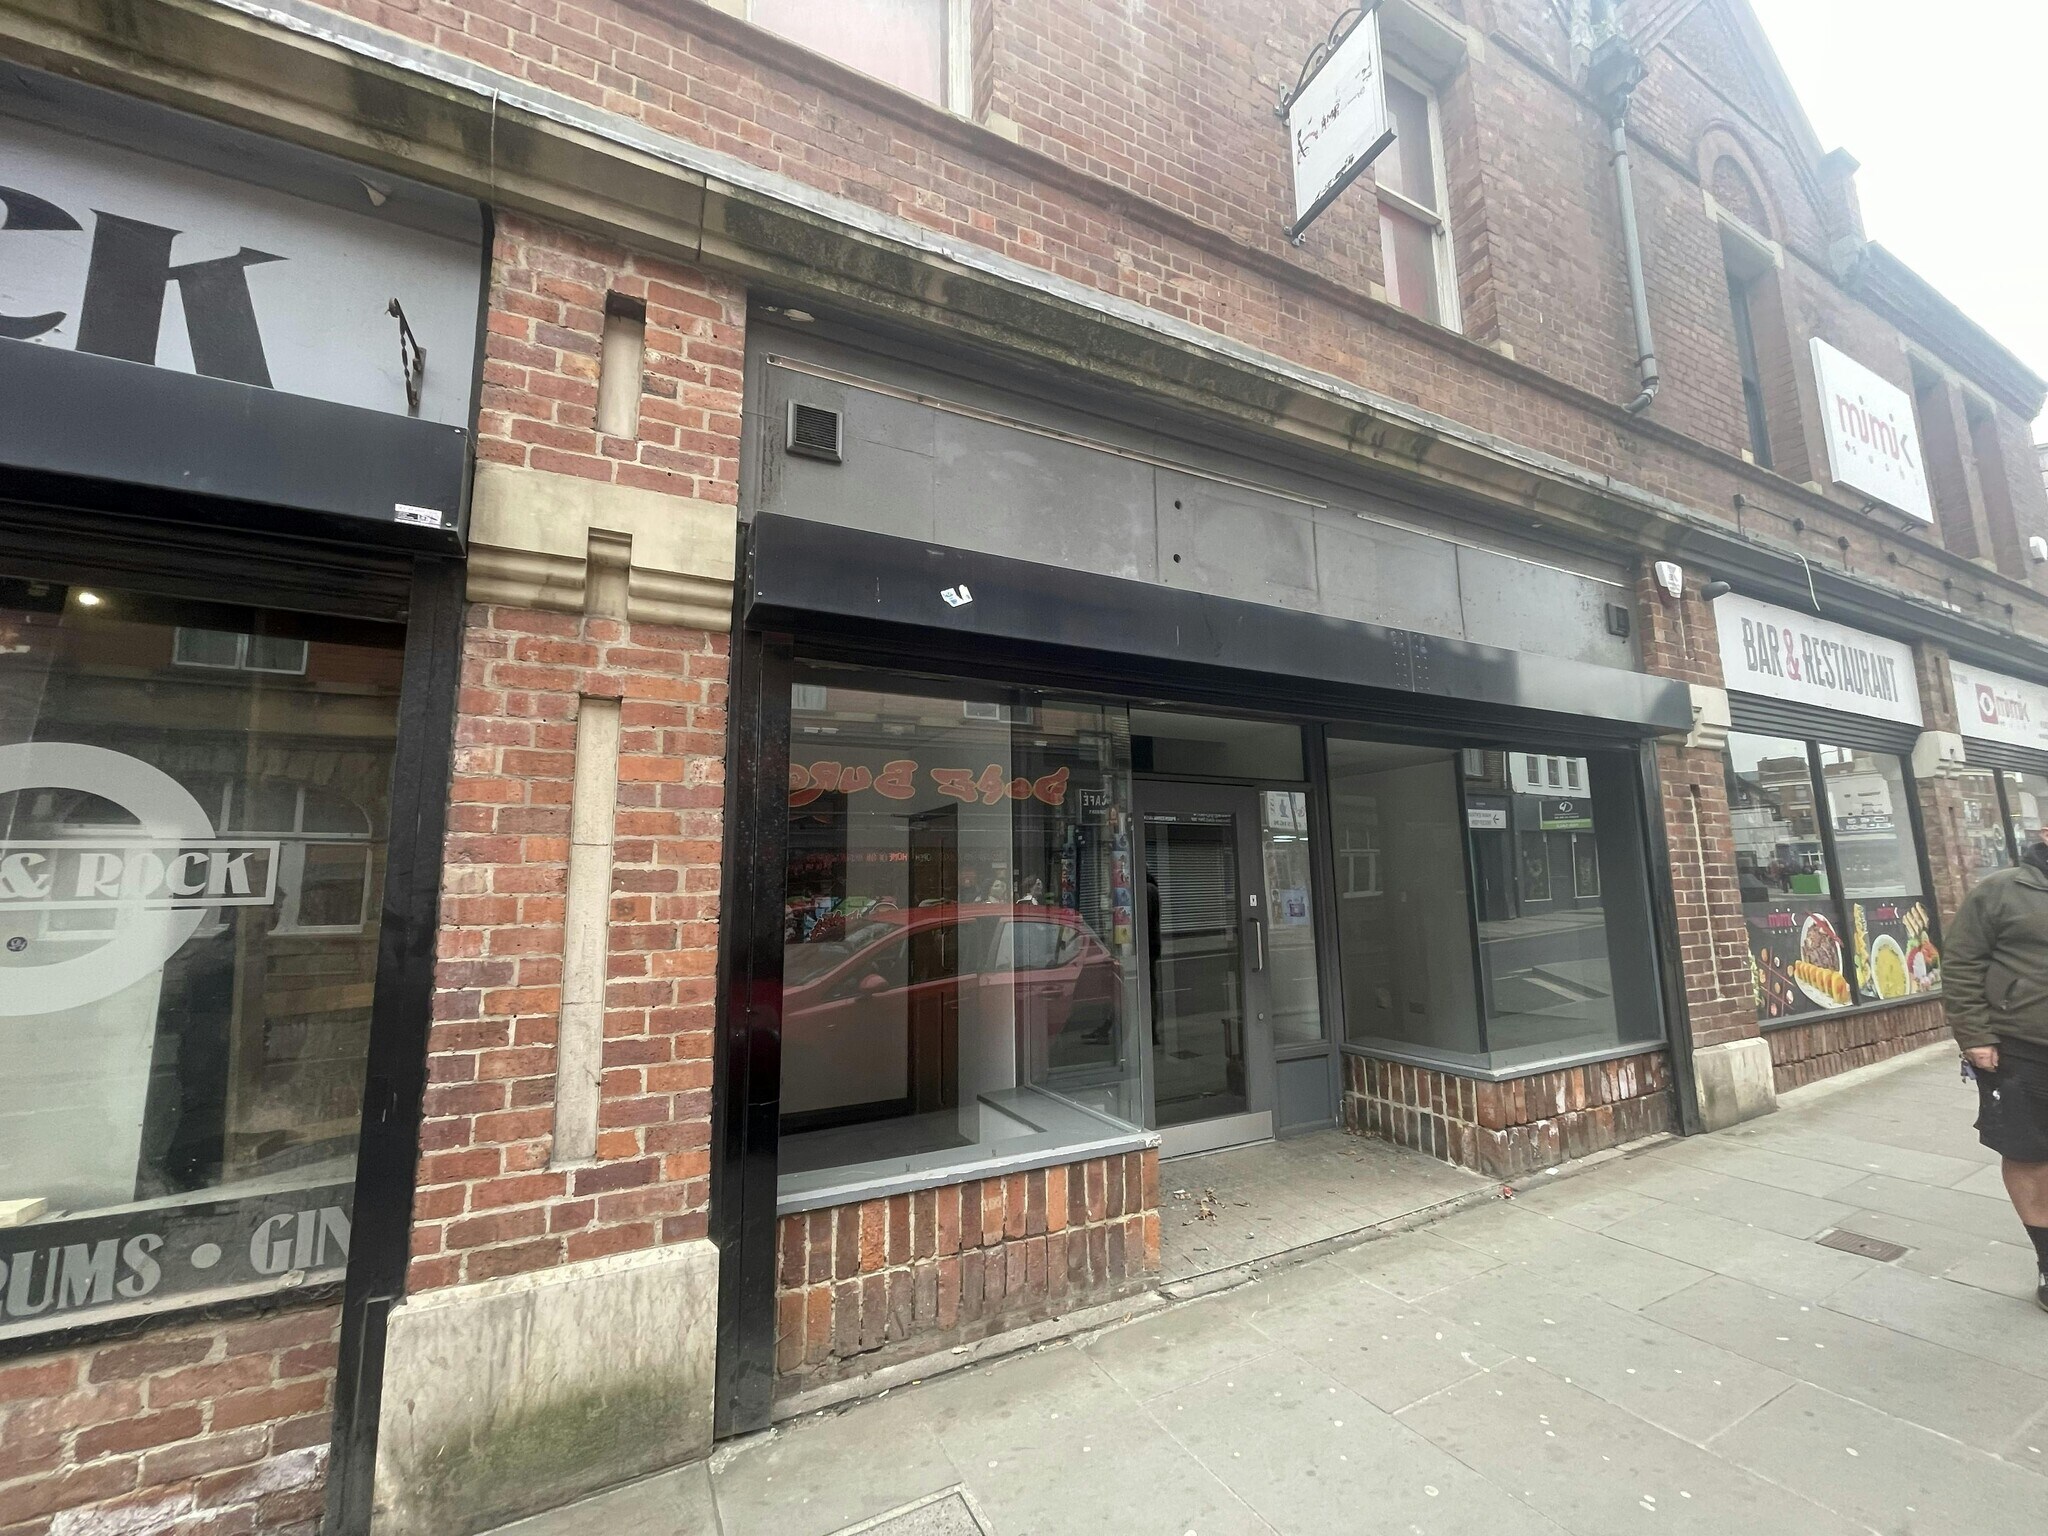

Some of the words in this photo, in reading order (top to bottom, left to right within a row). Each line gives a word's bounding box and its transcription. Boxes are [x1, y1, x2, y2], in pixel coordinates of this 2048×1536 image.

[1741, 617, 1784, 677] BAR
[1783, 628, 1802, 682] &
[1800, 633, 1899, 703] RESTAURANT
[0, 852, 51, 898] &
[75, 852, 253, 897] ROCK
[0, 1232, 164, 1317] UMS
